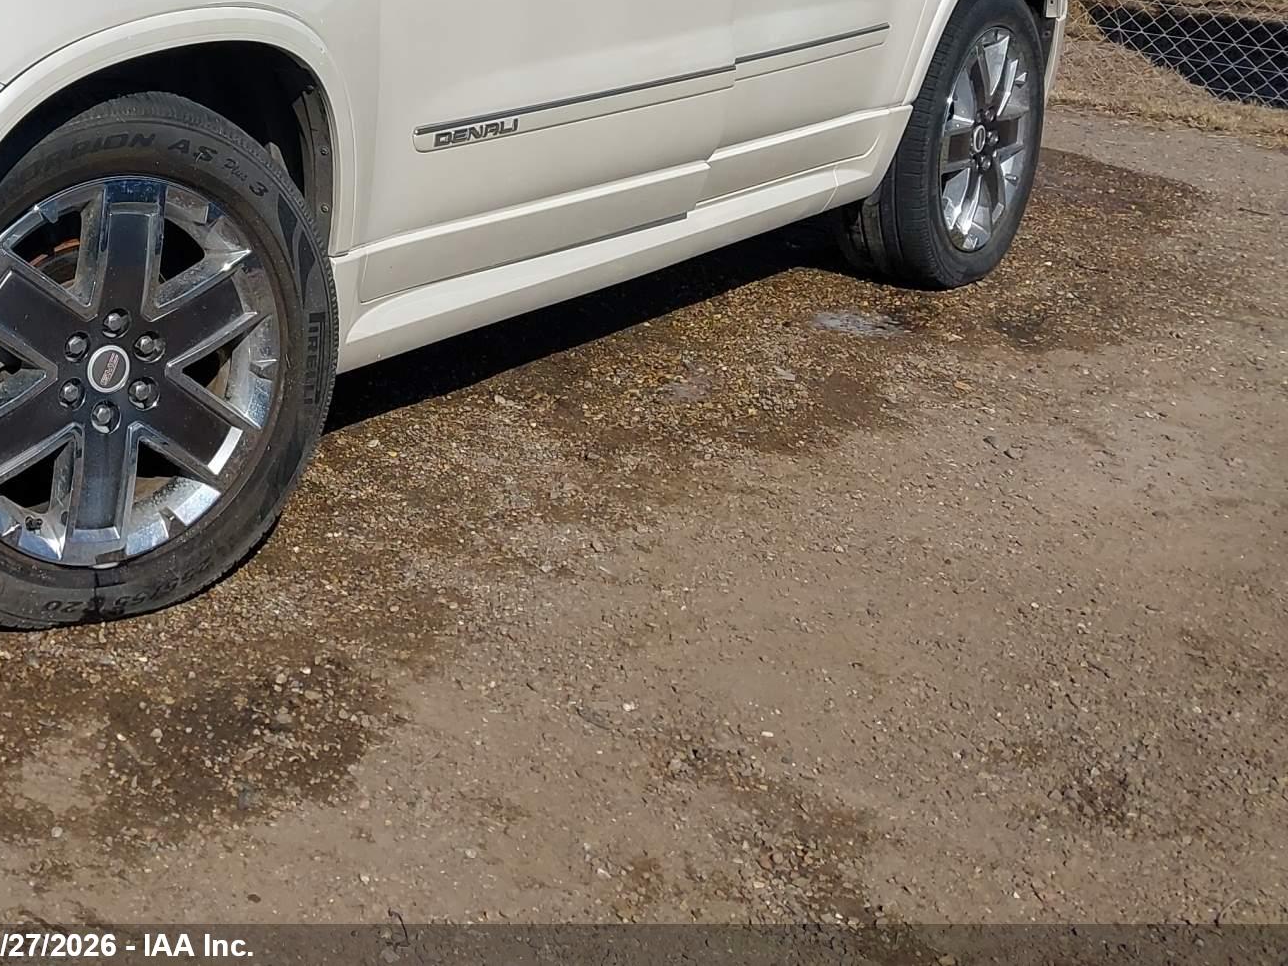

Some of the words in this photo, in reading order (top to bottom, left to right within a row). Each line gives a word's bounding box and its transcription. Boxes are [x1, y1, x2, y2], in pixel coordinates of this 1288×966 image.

[434, 119, 518, 147] DENALI
[167, 138, 218, 162] AS
[249, 182, 270, 198] 3
[301, 311, 326, 405] PIRELLI
